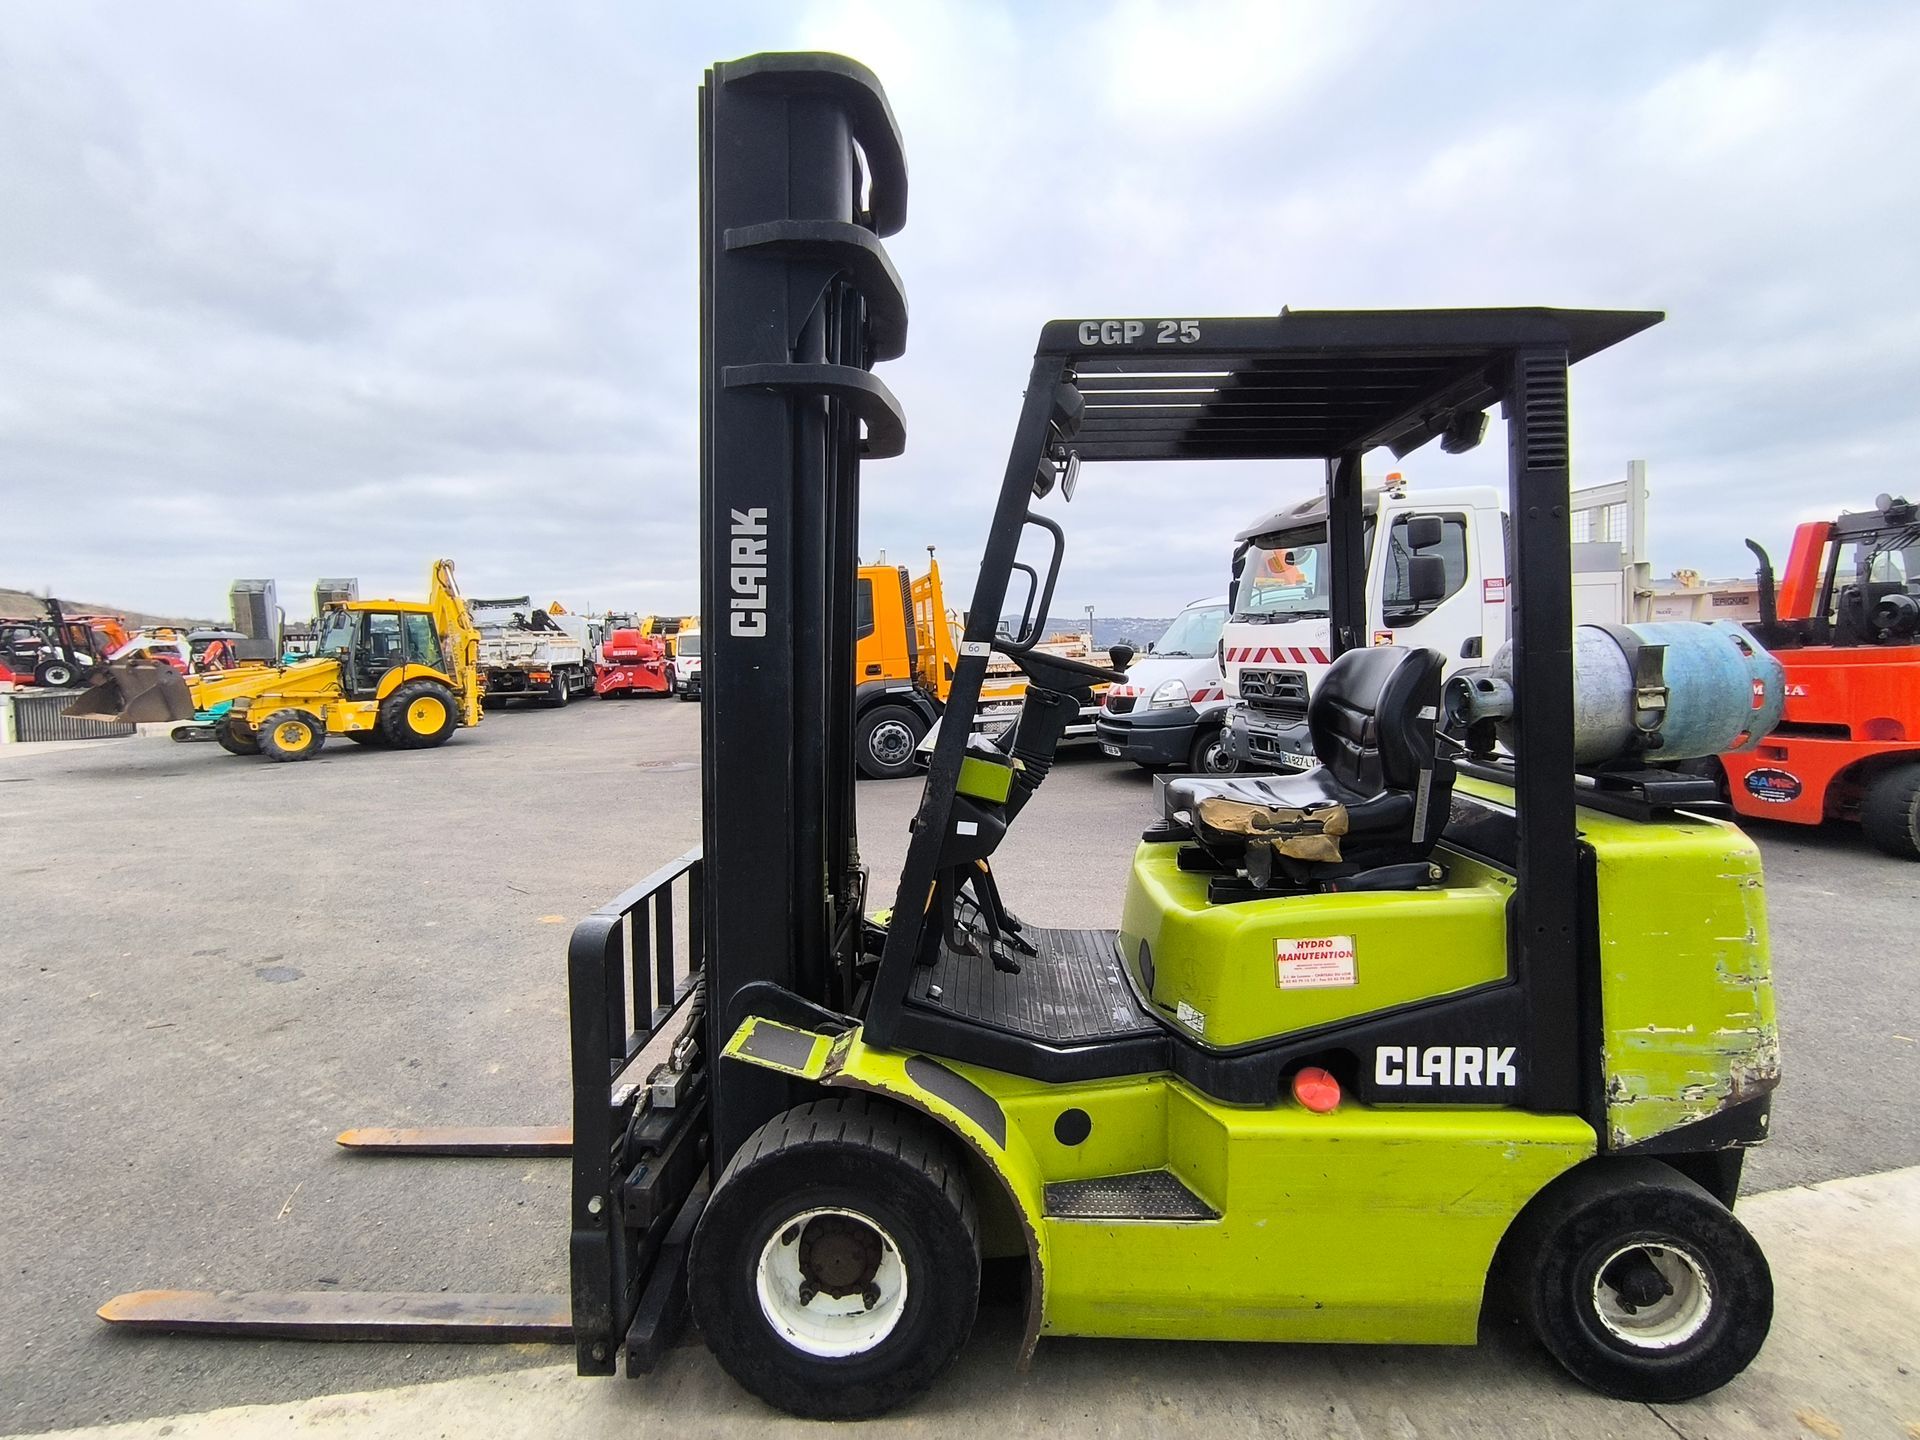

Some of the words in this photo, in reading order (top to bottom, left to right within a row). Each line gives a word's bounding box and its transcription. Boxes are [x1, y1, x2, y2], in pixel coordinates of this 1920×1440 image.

[1078, 321, 1145, 346] CGP
[1157, 321, 1201, 344] 25
[730, 507, 768, 637] CLARK
[968, 642, 980, 652] 60
[1296, 940, 1333, 949] HYDRO
[1277, 951, 1354, 962] MANUTENTION
[1375, 1045, 1517, 1087] CLARK
